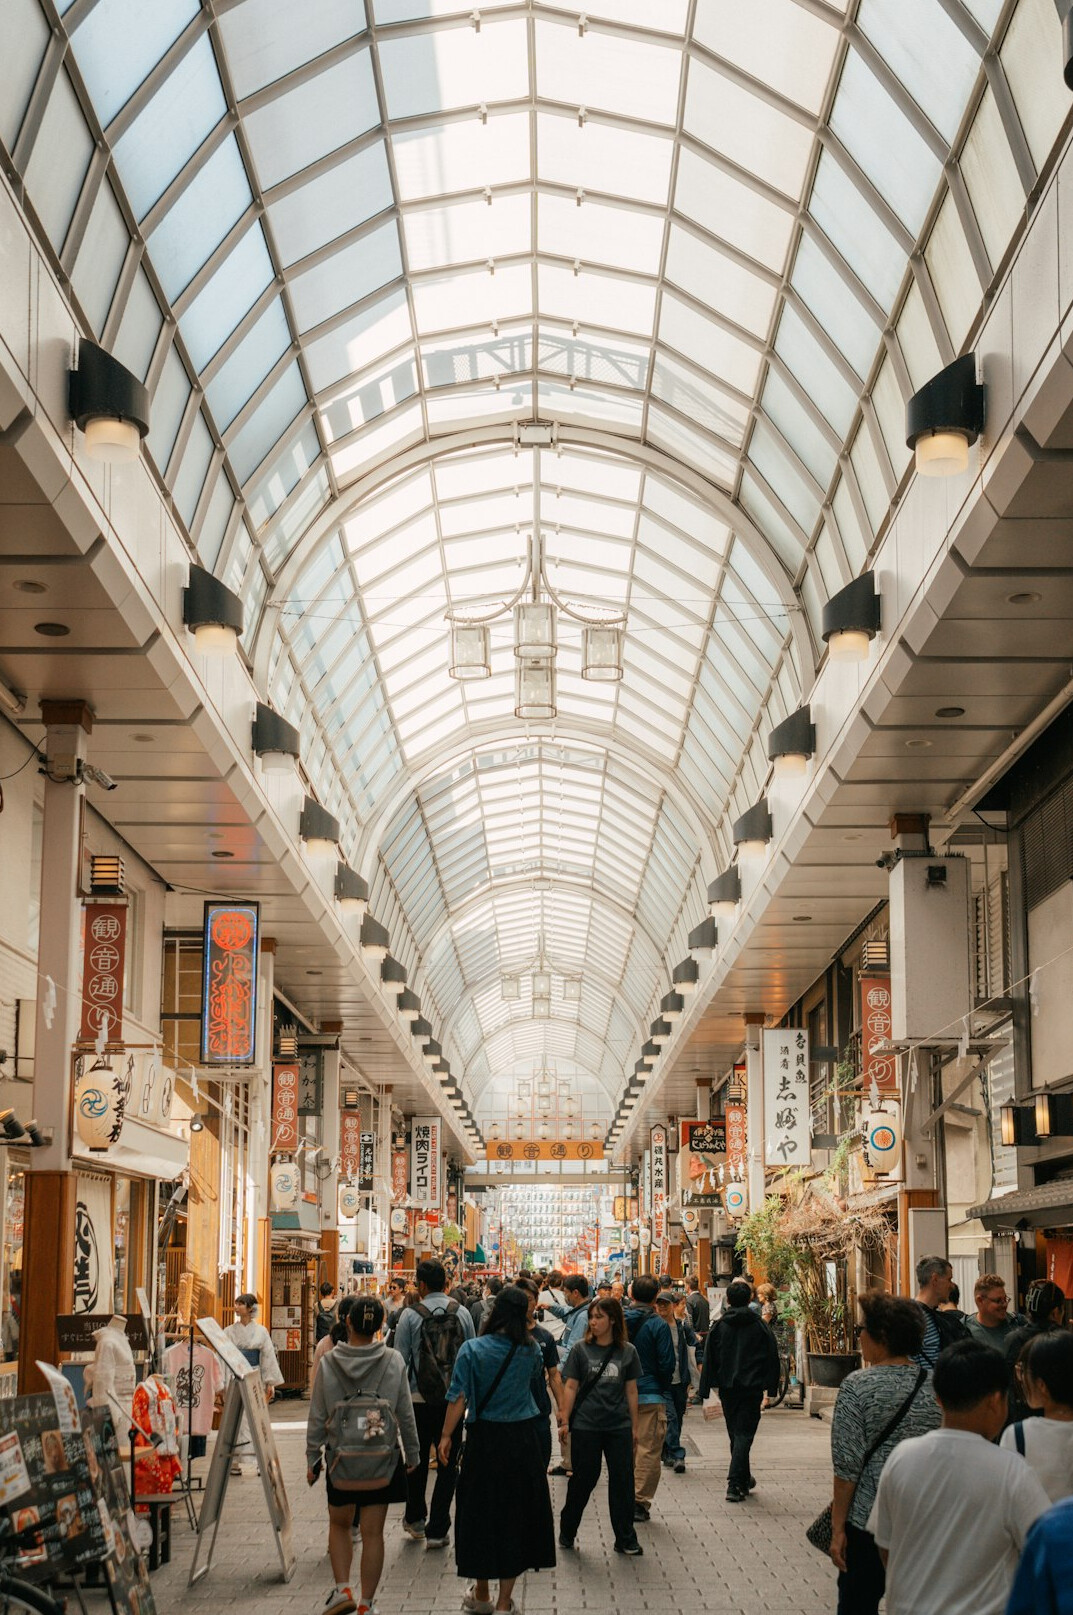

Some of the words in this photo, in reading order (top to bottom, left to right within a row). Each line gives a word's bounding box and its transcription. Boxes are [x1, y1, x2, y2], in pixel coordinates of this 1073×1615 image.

[87, 914, 121, 1033] 観音通り
[866, 986, 892, 1082] 観音通り
[276, 1071, 295, 1141] 観音通り
[415, 1125, 430, 1187] 焼肉ライク
[496, 1142, 594, 1160] 観音通り
[654, 1145, 664, 1189] 磯丸水産
[728, 1110, 744, 1166] 観音通り
